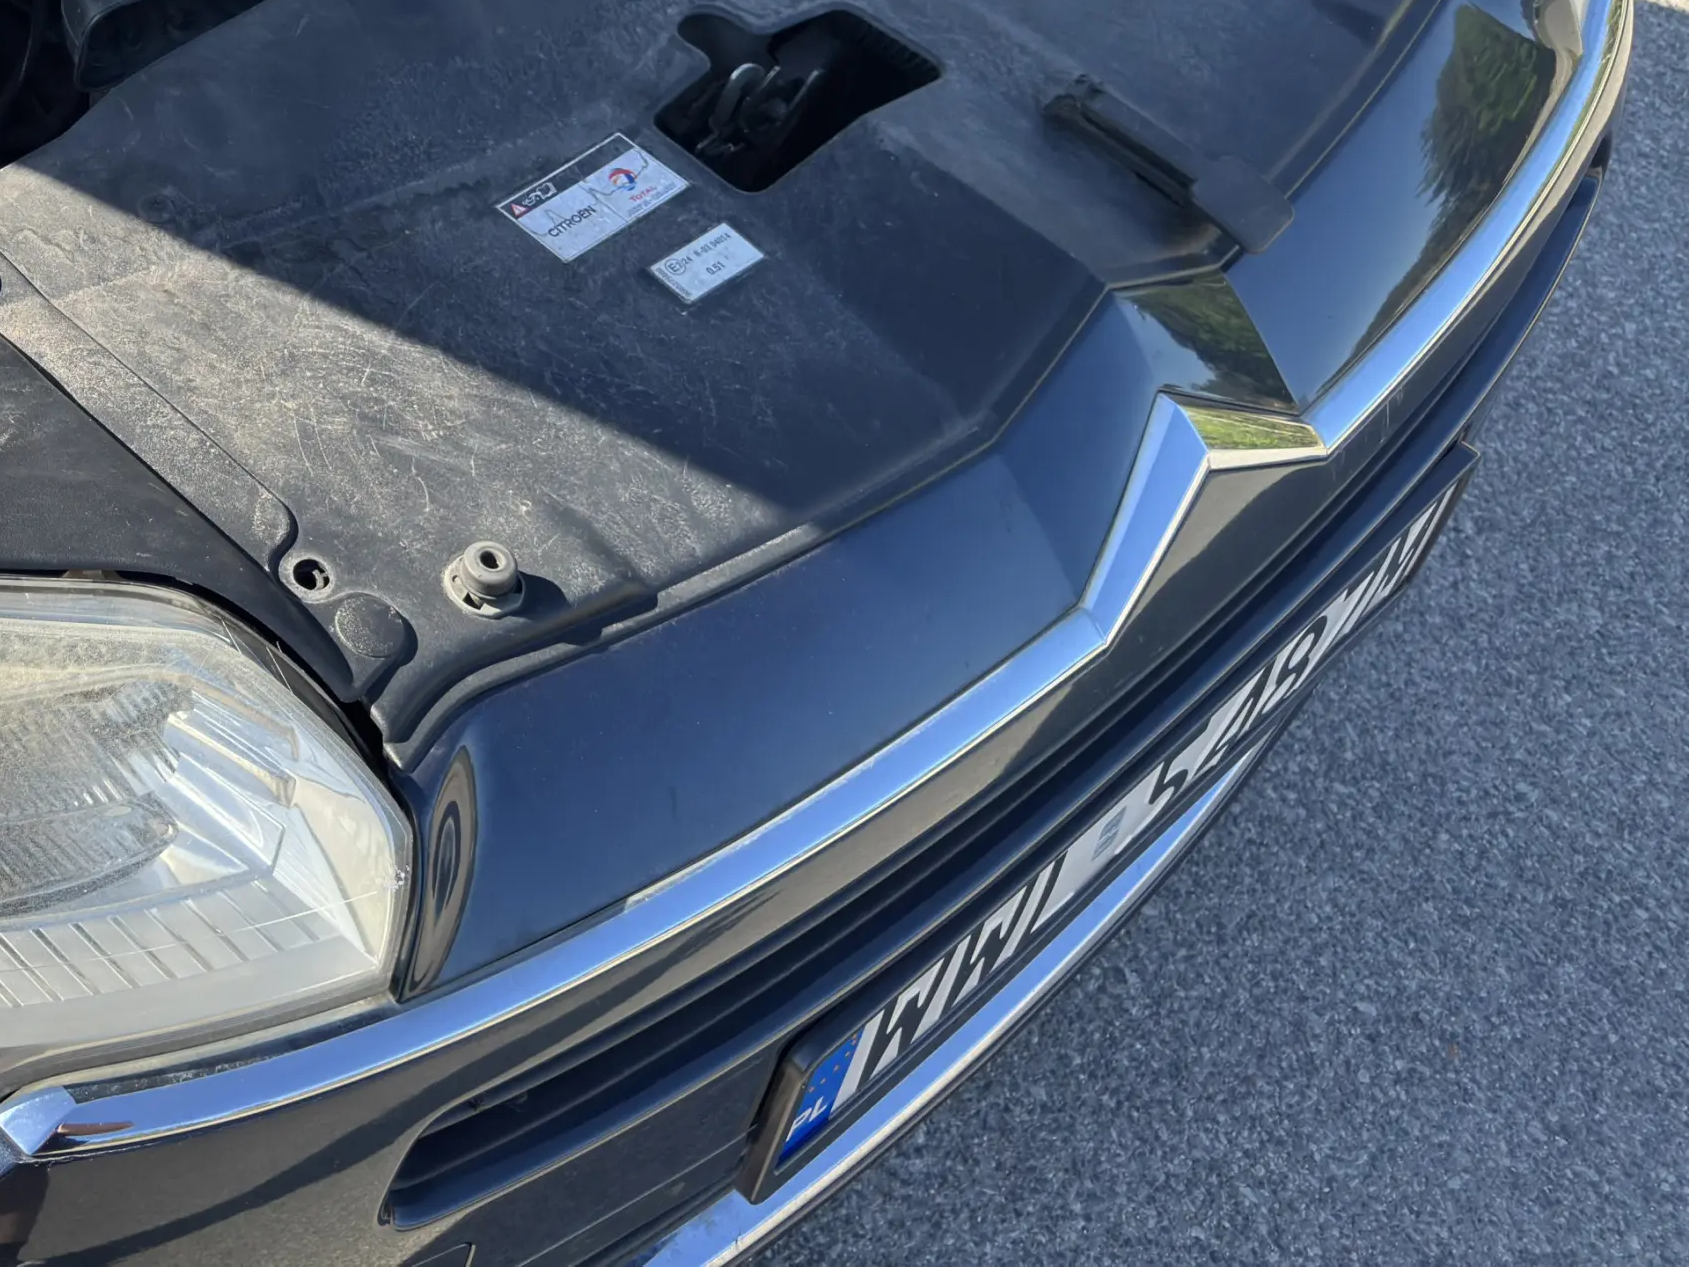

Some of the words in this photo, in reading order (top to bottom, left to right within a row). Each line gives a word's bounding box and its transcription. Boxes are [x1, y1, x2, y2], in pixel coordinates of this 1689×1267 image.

[547, 204, 597, 237] CITROËN
[857, 850, 1074, 1089] WWL
[785, 1094, 828, 1142] PL
